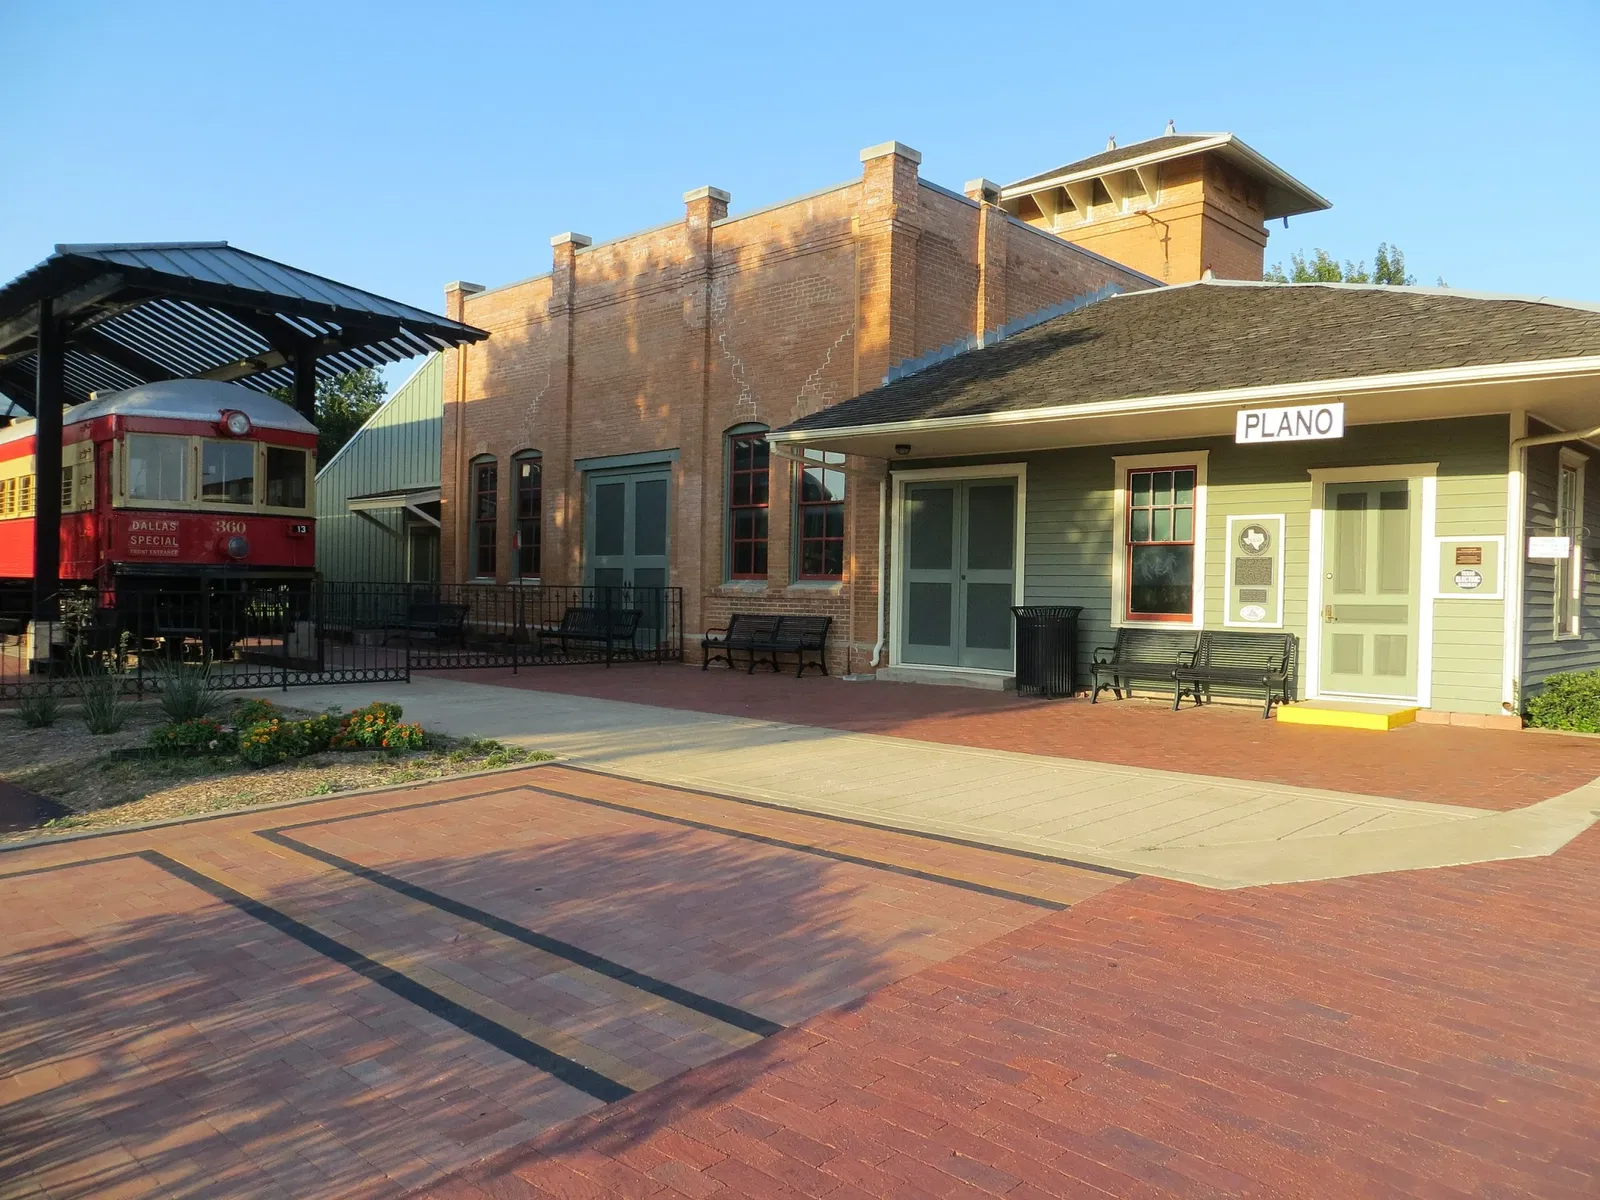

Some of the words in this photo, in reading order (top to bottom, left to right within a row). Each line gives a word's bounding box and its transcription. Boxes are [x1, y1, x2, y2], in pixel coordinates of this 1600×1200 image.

[1245, 408, 1333, 439] PLANO
[132, 520, 177, 531] DALLAS
[216, 520, 246, 534] 360
[297, 525, 307, 533] 13
[130, 535, 179, 547] SPECIAL
